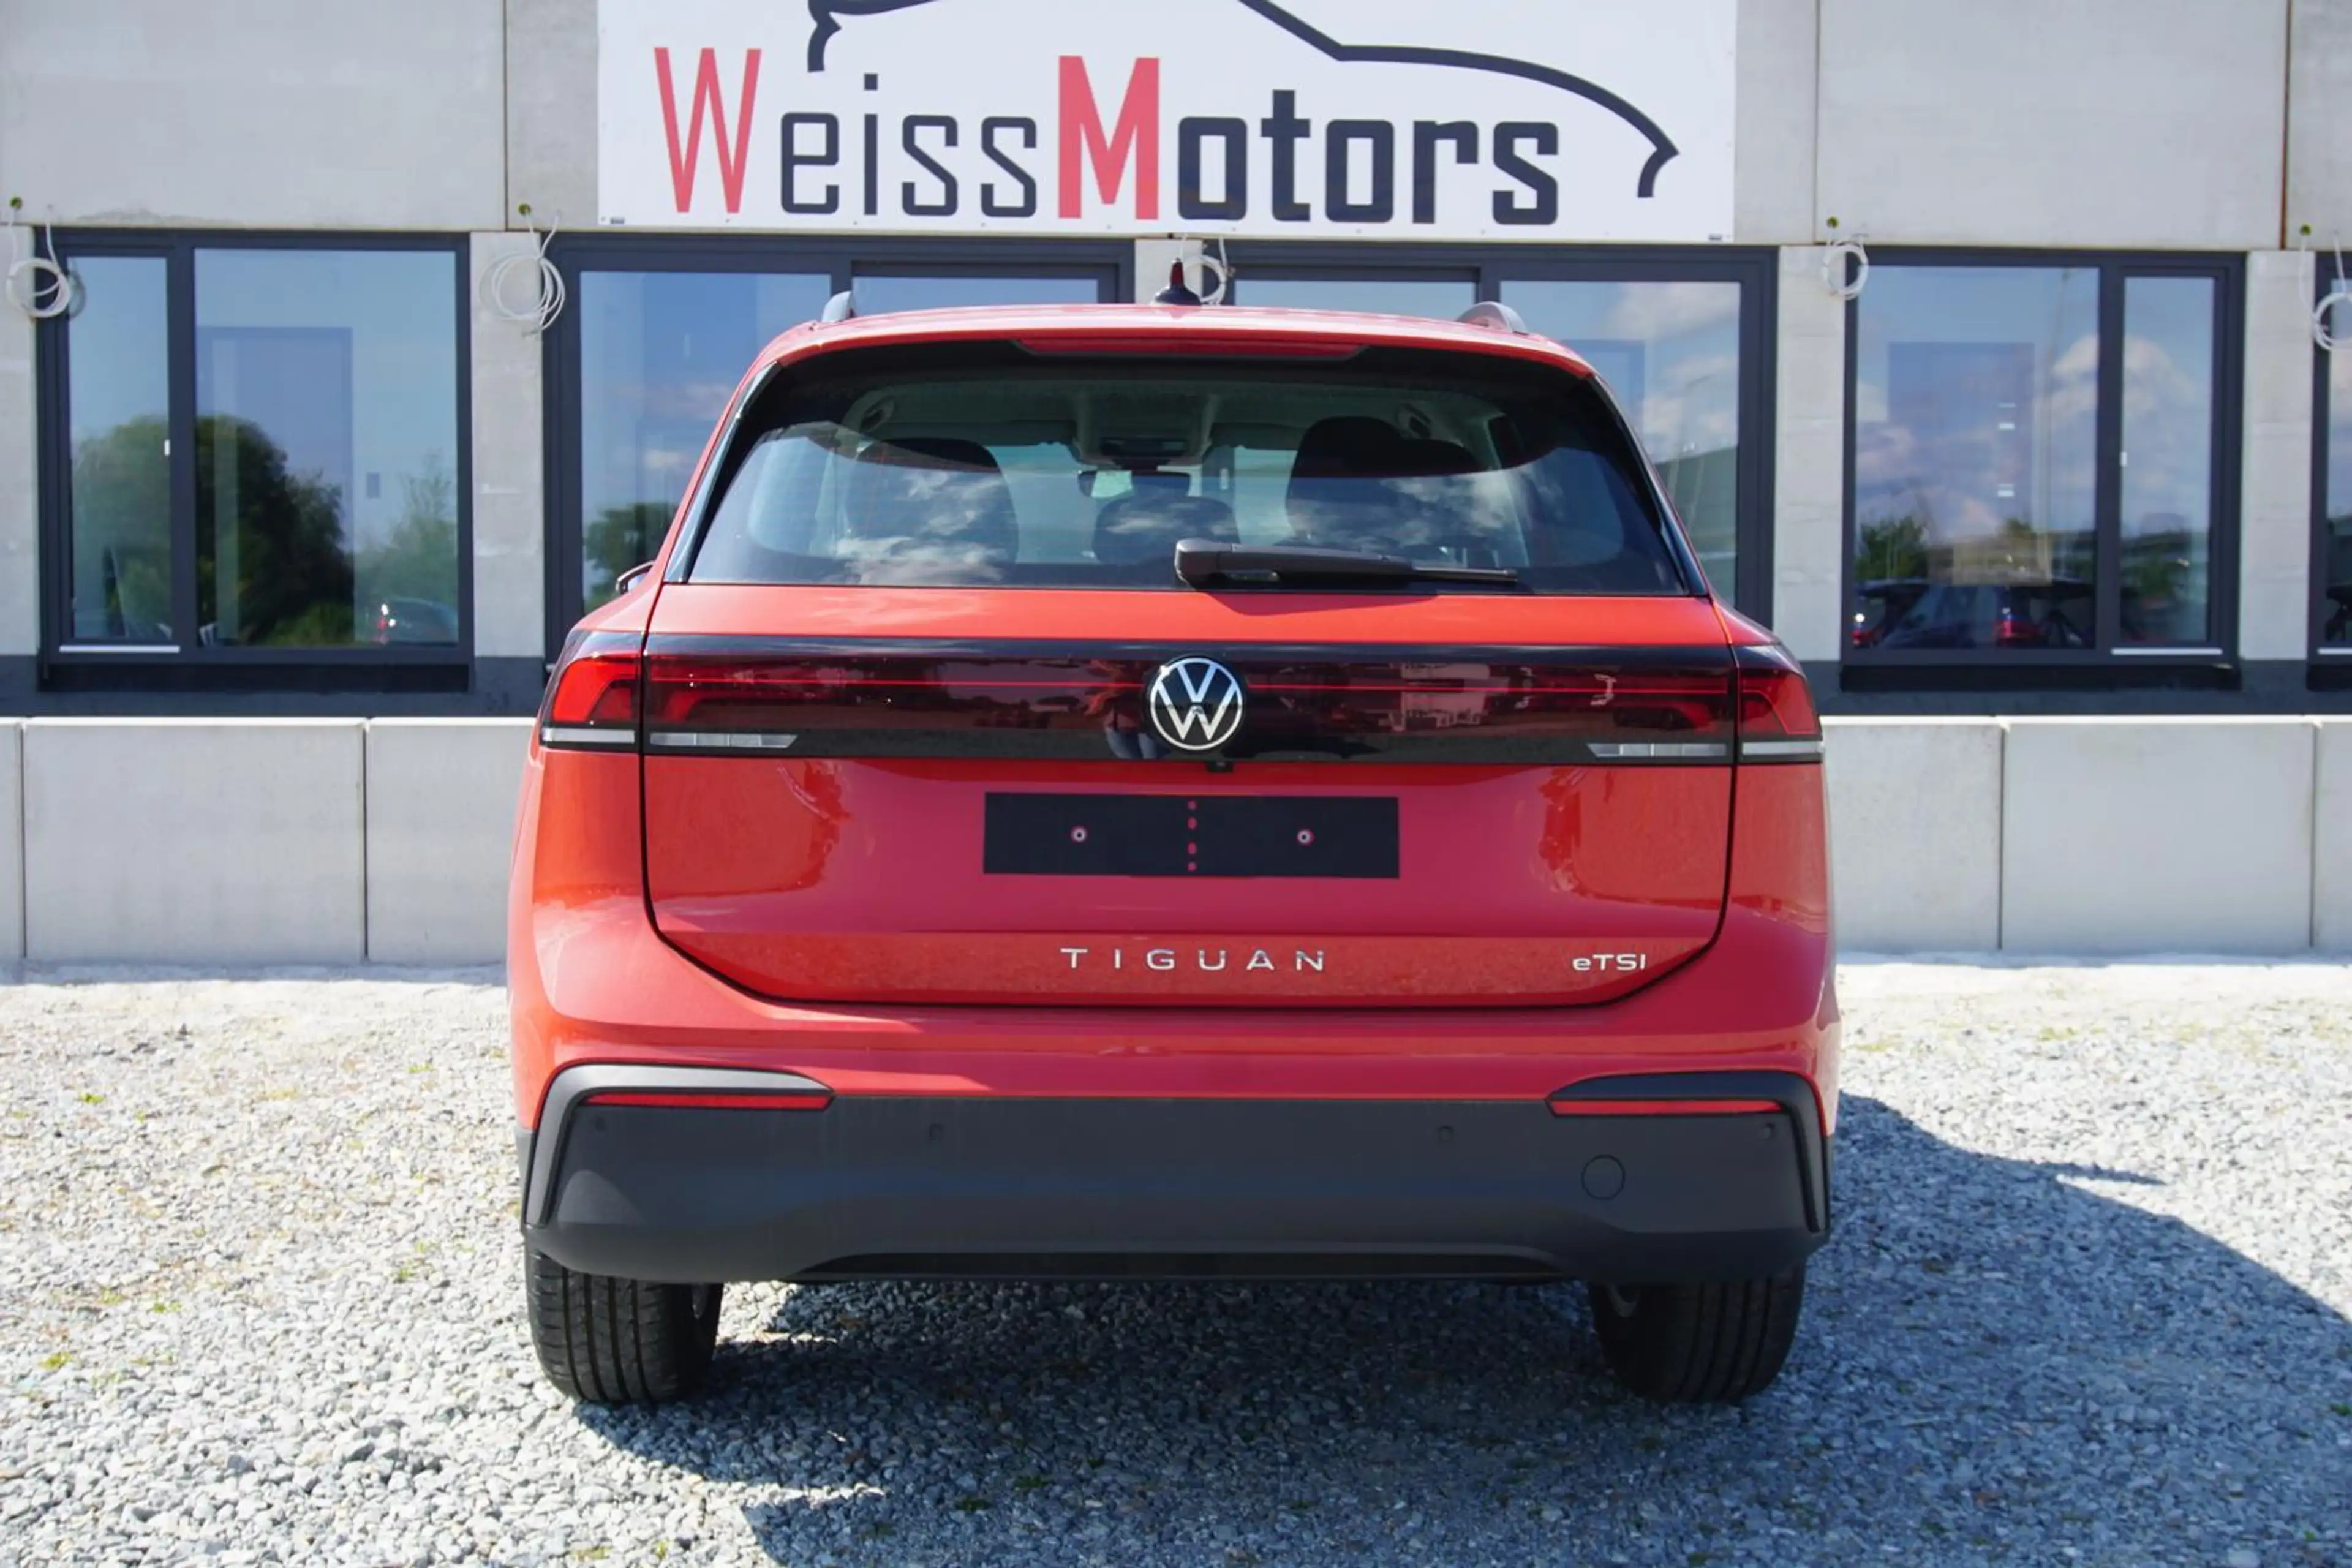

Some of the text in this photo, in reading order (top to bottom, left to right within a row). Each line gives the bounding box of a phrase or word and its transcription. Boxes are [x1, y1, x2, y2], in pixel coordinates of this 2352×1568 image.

[655, 47, 1559, 227] WeissMotors
[1153, 662, 1241, 745] VW
[1060, 948, 1325, 971] TIGUAN
[1572, 953, 1646, 971] eTSI
